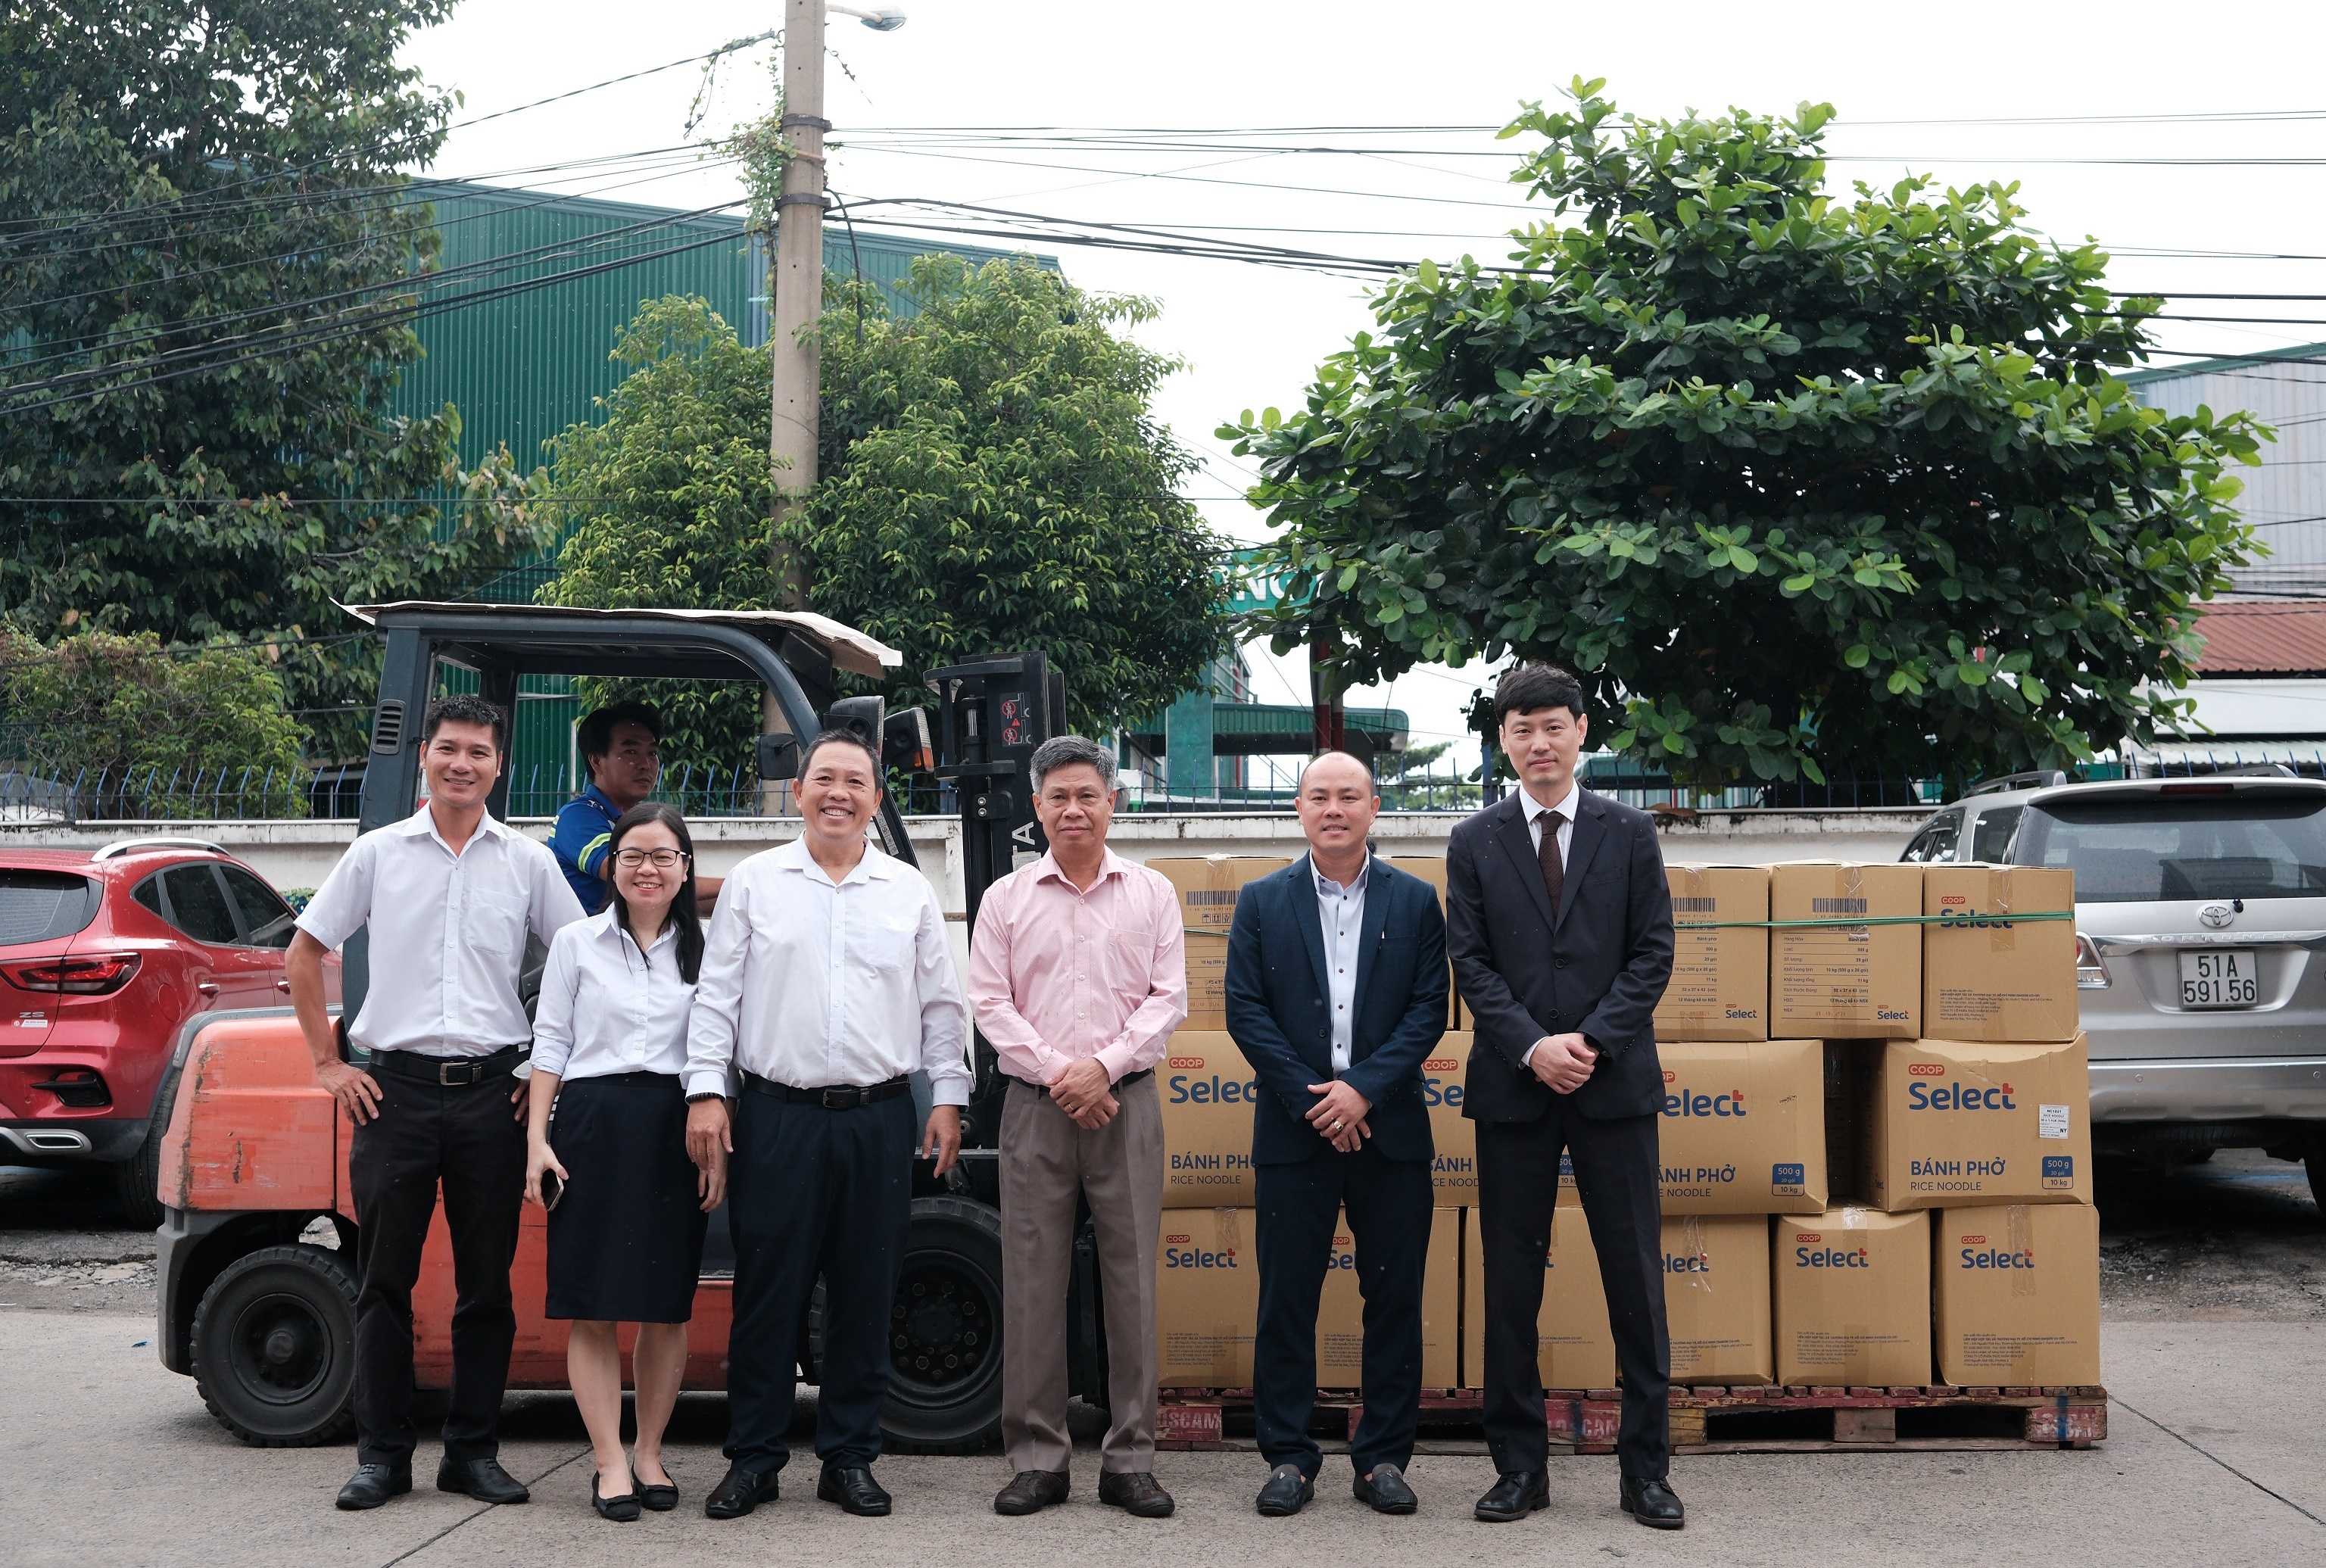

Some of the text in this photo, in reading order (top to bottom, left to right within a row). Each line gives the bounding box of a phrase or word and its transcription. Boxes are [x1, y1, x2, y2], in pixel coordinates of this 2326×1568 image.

[1941, 909, 2013, 928] Select
[2140, 932, 2297, 945] FORTUNER
[2197, 954, 2238, 978] 51A
[2183, 979, 2256, 1003] 591.56
[1726, 1009, 1757, 1018] Select
[1878, 1010, 1910, 1020] Select
[1171, 1058, 1203, 1068] COOP
[1423, 1061, 1457, 1070] COOP
[1910, 1065, 1944, 1074] COOP
[1909, 1082, 2016, 1110] Select
[1662, 1089, 1747, 1117] elect
[1171, 1151, 1249, 1170] BÁNH PH
[1911, 1156, 2006, 1177] BÁNH PHỞ
[2047, 1159, 2069, 1170] 500 g
[1659, 1164, 1736, 1183] ÁNH PHỞ
[1777, 1167, 1801, 1177] 500 g
[1171, 1175, 1242, 1184] RICE NOODLE
[1433, 1177, 1480, 1187] CE NOOD
[2059, 1179, 2068, 1187] kg
[1667, 1188, 1711, 1197] NOODLE
[1911, 1182, 1982, 1191] RICE NOODLE
[1166, 1248, 1238, 1268] Select
[1660, 1253, 1710, 1273] lect
[1796, 1247, 1869, 1267] Select
[1961, 1248, 2034, 1268] Select
